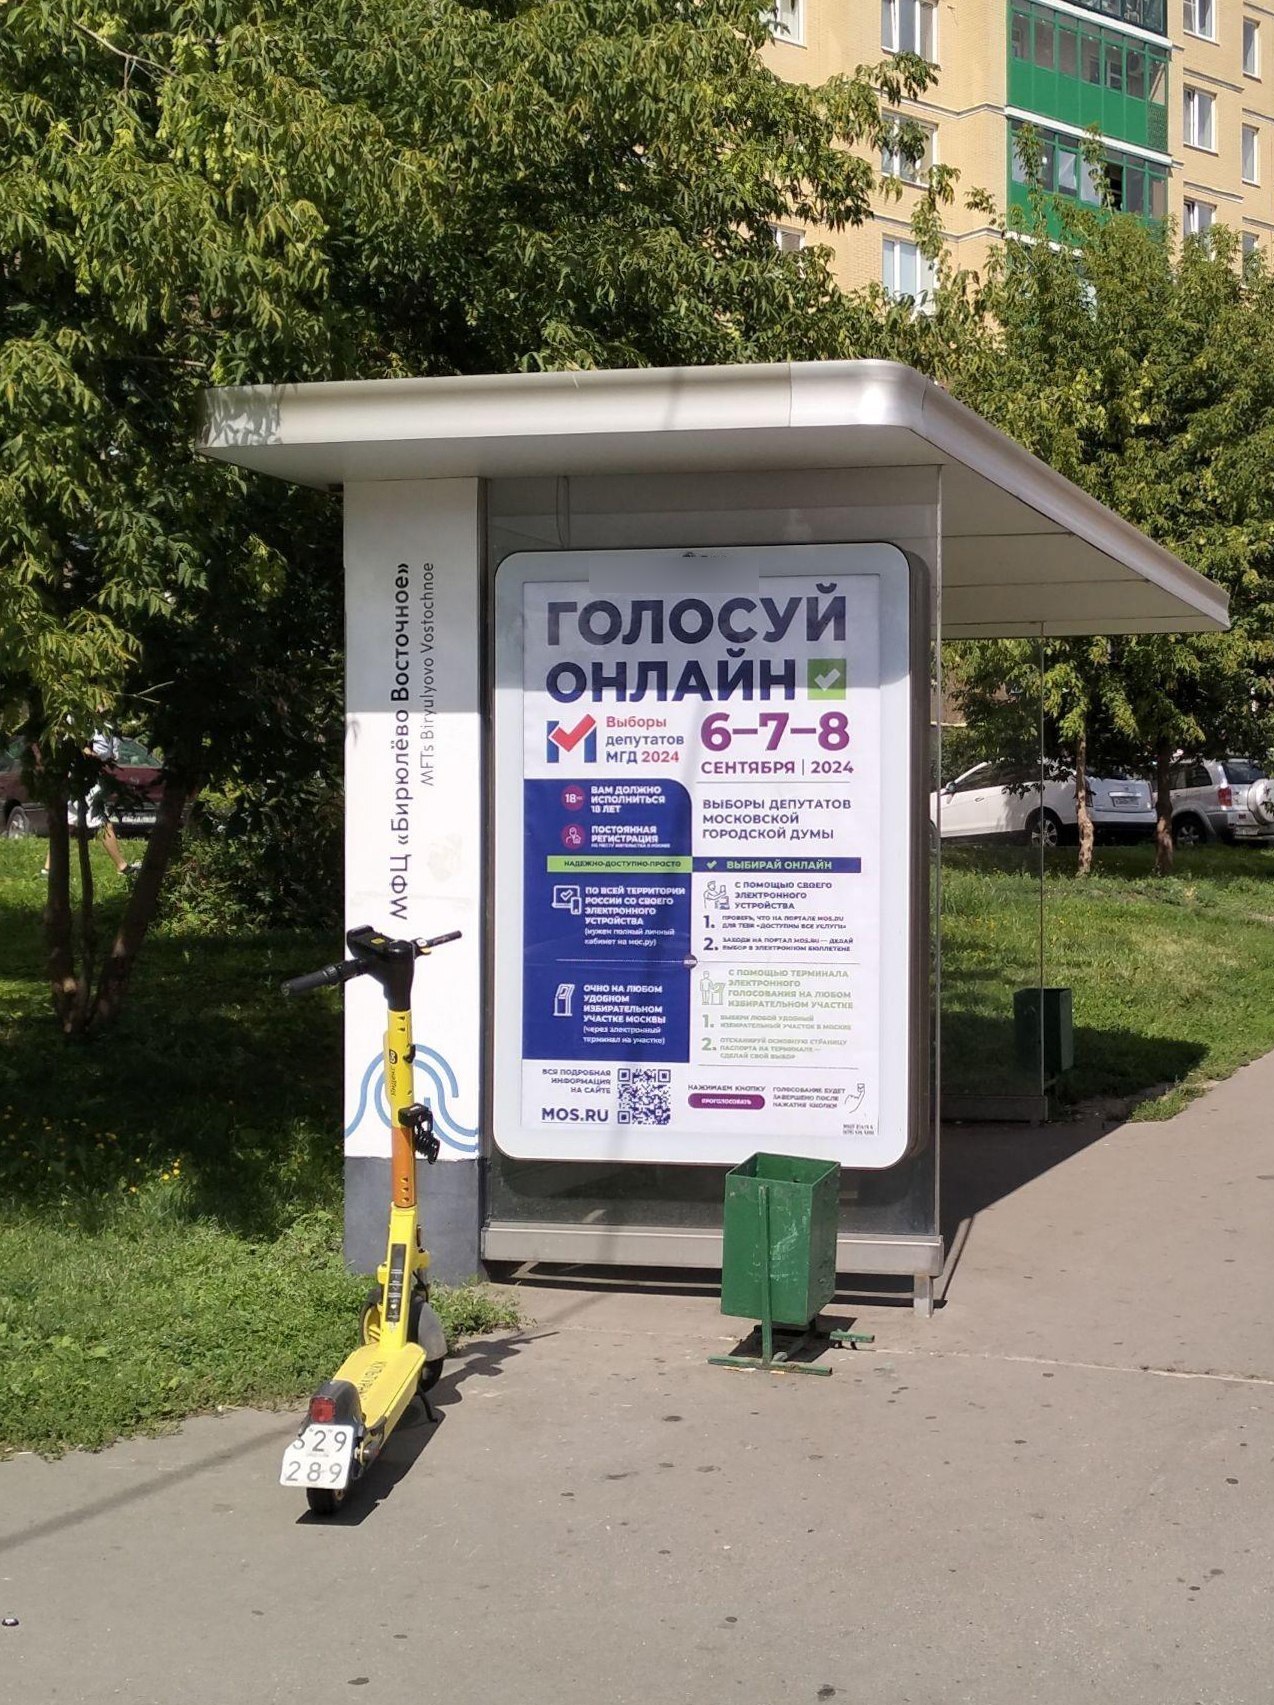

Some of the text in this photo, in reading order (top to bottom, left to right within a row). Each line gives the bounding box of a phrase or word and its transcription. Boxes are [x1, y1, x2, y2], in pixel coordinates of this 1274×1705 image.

[547, 582, 847, 646] ГОЛОСУЙ
[420, 562, 436, 786] MFTs Biryulyovo Vostochnoe
[546, 647, 796, 703] ОНЛАЙН
[606, 716, 667, 730] Выборы
[390, 563, 413, 920] МФЦ «Бирюлёво Восточное»
[606, 733, 684, 747] депутатов
[606, 750, 680, 765] МГД 2024
[701, 760, 854, 774] СЕНТЯБРЯ 2024
[615, 786, 661, 795] ДОЛЖНО
[703, 800, 851, 811] ВЫБОРЫ ДЕПУТАТОВ
[703, 812, 799, 824] МОСКОВСКОЙ
[591, 835, 658, 843] РЕГИСТРАЦИЯ
[703, 827, 833, 840] ГОРОДСКОЙ ДУМЫ
[726, 859, 832, 869] ВЫБИРАЙ ОНЛАЙН
[601, 886, 624, 894] ВСЕЙ
[585, 917, 644, 925] УСТРОЙСТВА
[703, 915, 714, 928] 1.
[703, 937, 718, 951] 2.
[584, 995, 629, 1003] УДОБНОМ
[541, 1108, 609, 1122] MOS.RU
[286, 1461, 342, 1483] 289
